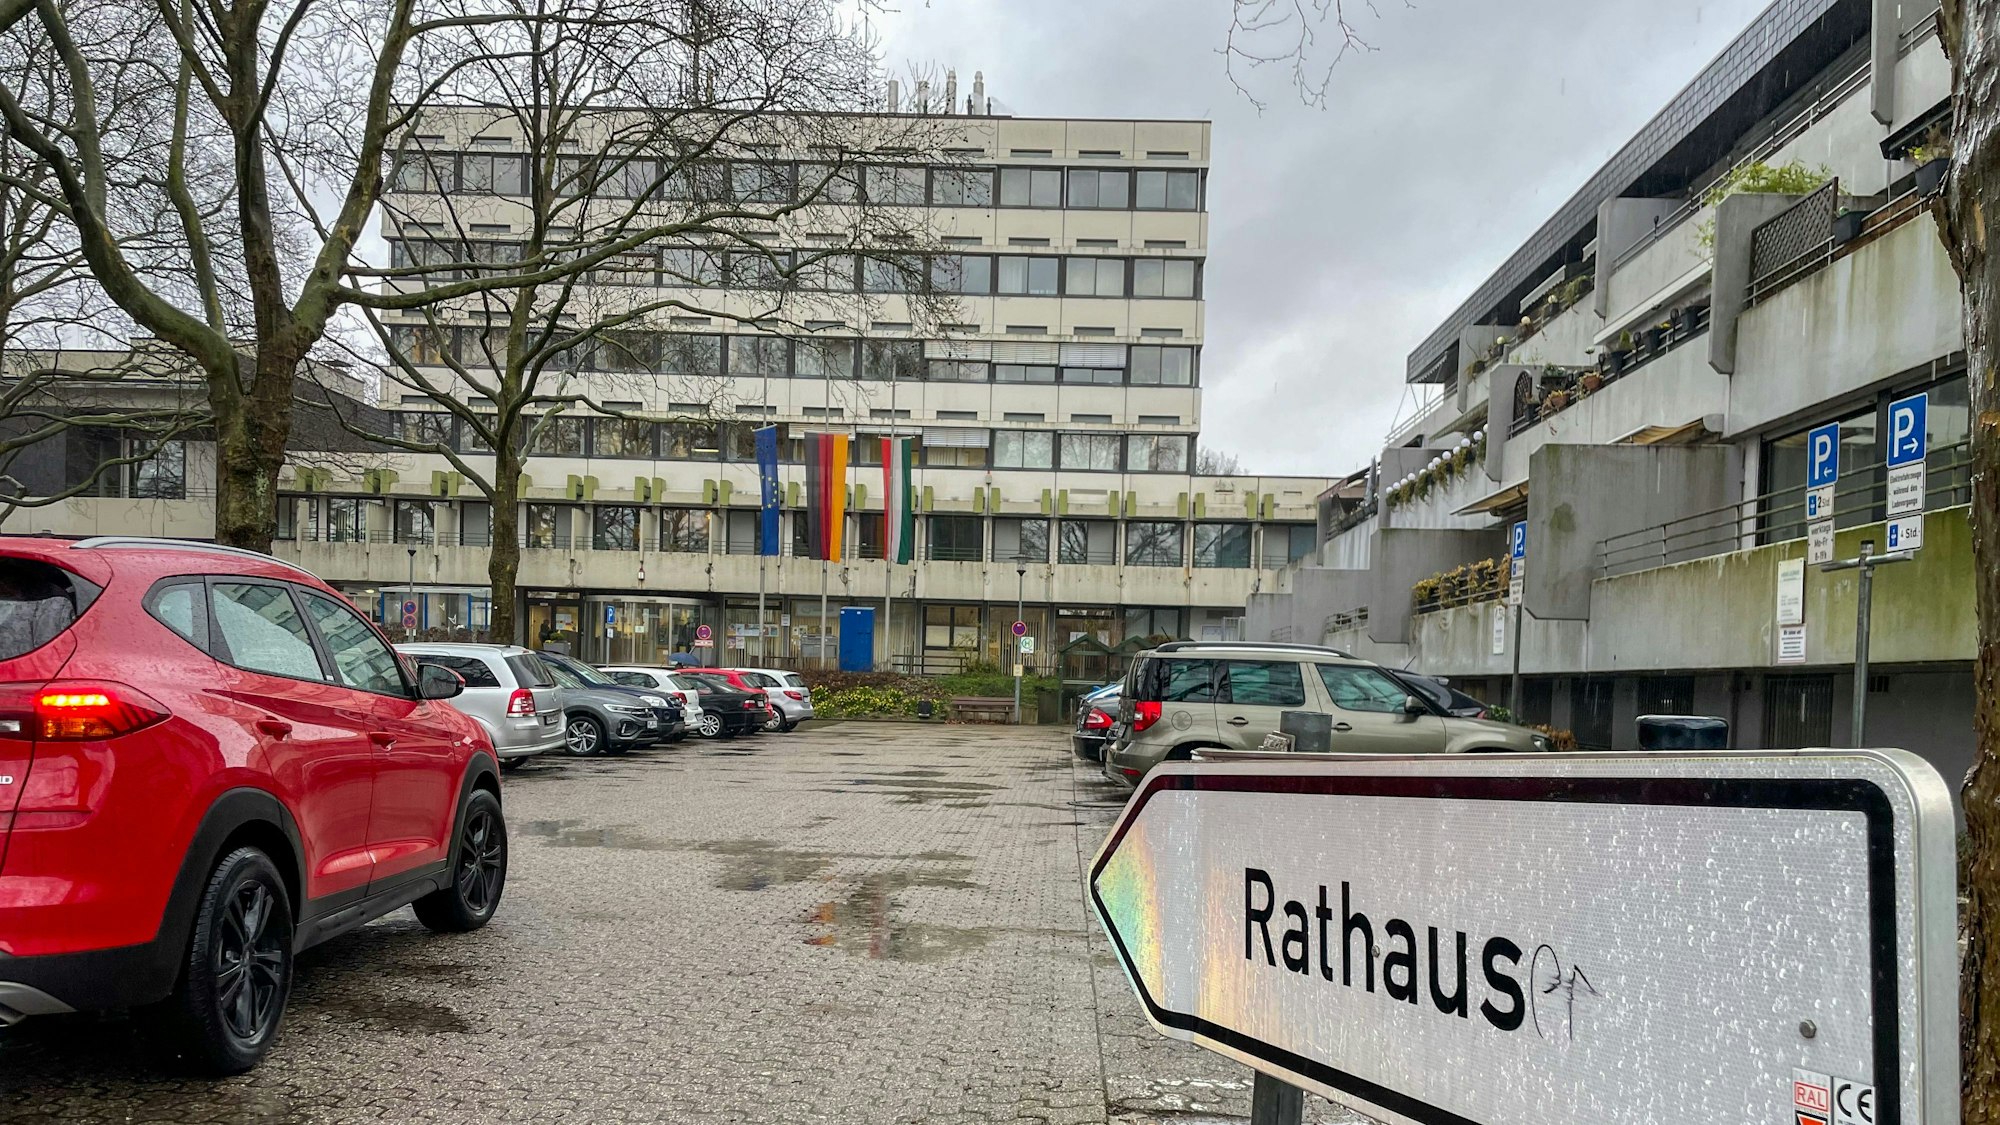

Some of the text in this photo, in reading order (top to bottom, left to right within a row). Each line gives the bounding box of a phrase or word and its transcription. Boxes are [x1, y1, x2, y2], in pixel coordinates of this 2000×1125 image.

[1894, 407, 1914, 458] P
[1815, 434, 1832, 480] P
[1515, 527, 1523, 555] P
[608, 608, 614, 621] P
[1245, 867, 1525, 1031] Rathaus
[1797, 1086, 1825, 1108] RAL
[1836, 1083, 1873, 1124] CE
